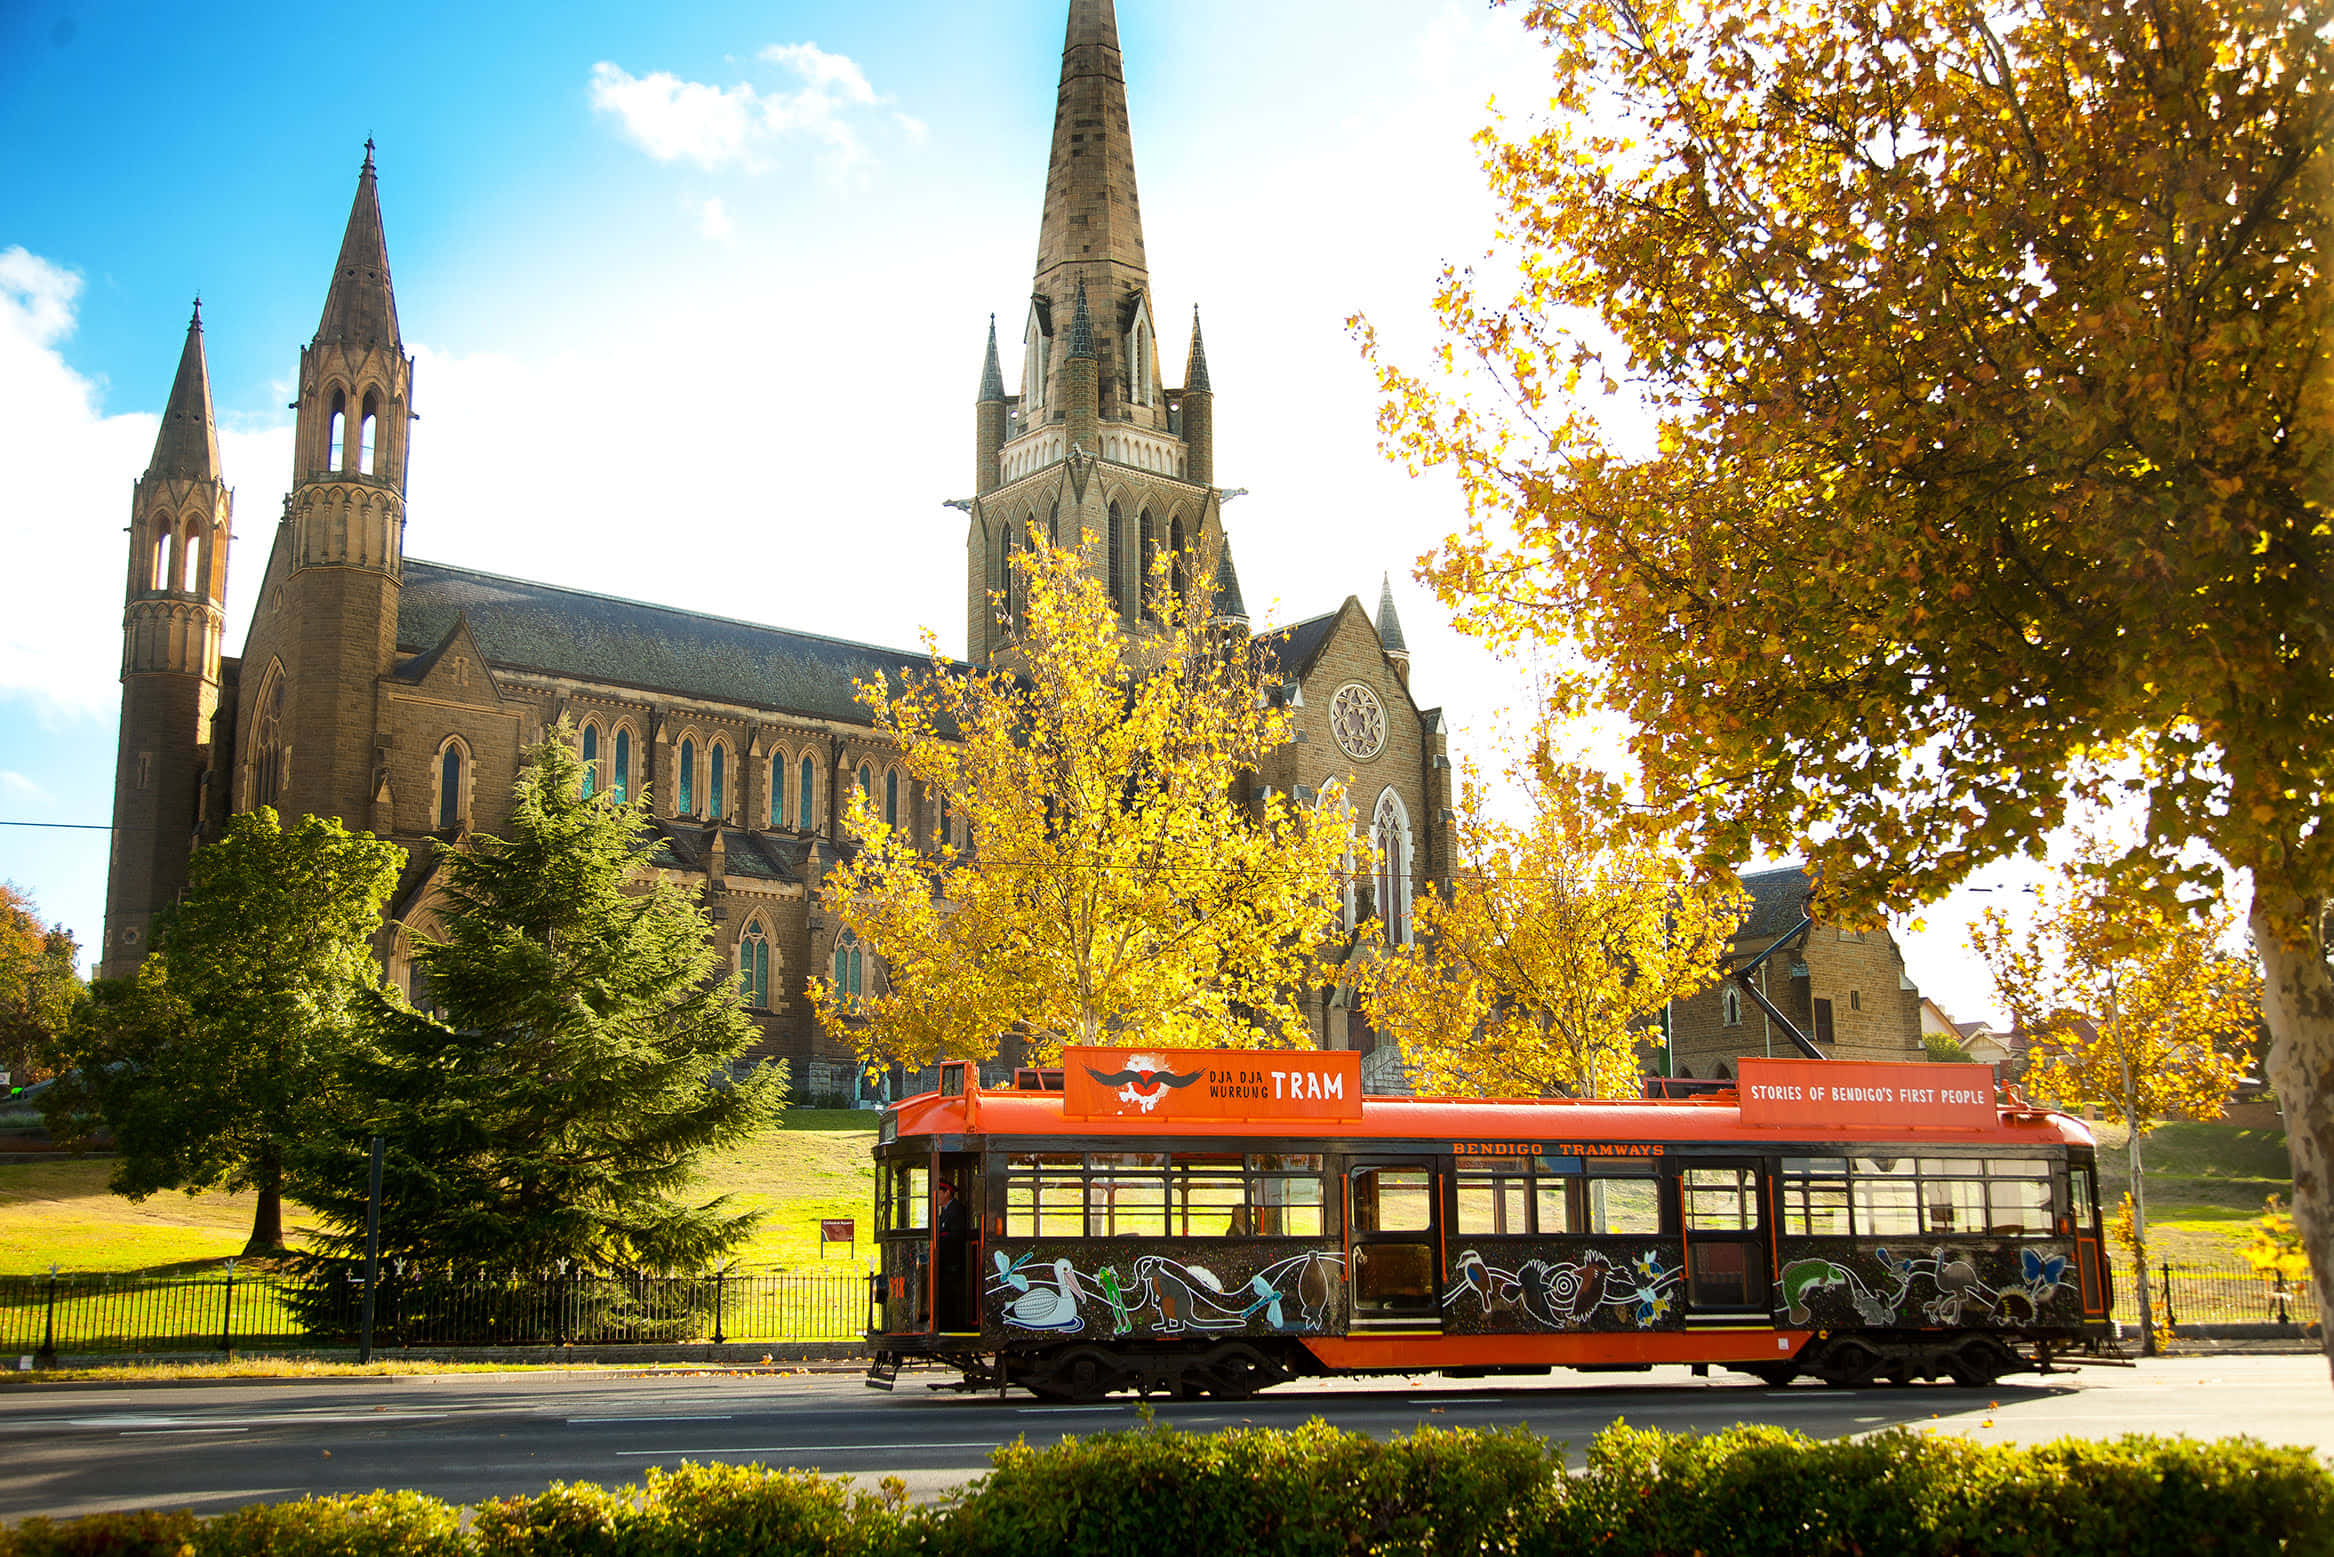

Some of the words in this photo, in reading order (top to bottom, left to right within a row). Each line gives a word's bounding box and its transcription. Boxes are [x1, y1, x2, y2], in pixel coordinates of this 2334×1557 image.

[1209, 1071, 1233, 1084] DJA
[1239, 1071, 1263, 1084] DJA
[1209, 1085, 1269, 1099] WURRUNG
[1271, 1071, 1343, 1100] TRAM
[1751, 1085, 1802, 1100] STORIES
[1809, 1086, 1825, 1100] OF
[1832, 1087, 1893, 1102] BENDIGO'S
[1900, 1088, 1934, 1103] FIRST
[1941, 1089, 1985, 1104] PEOPLE
[1452, 1143, 1543, 1155] BENDIGO
[1559, 1143, 1665, 1156] TRAMWAYS
